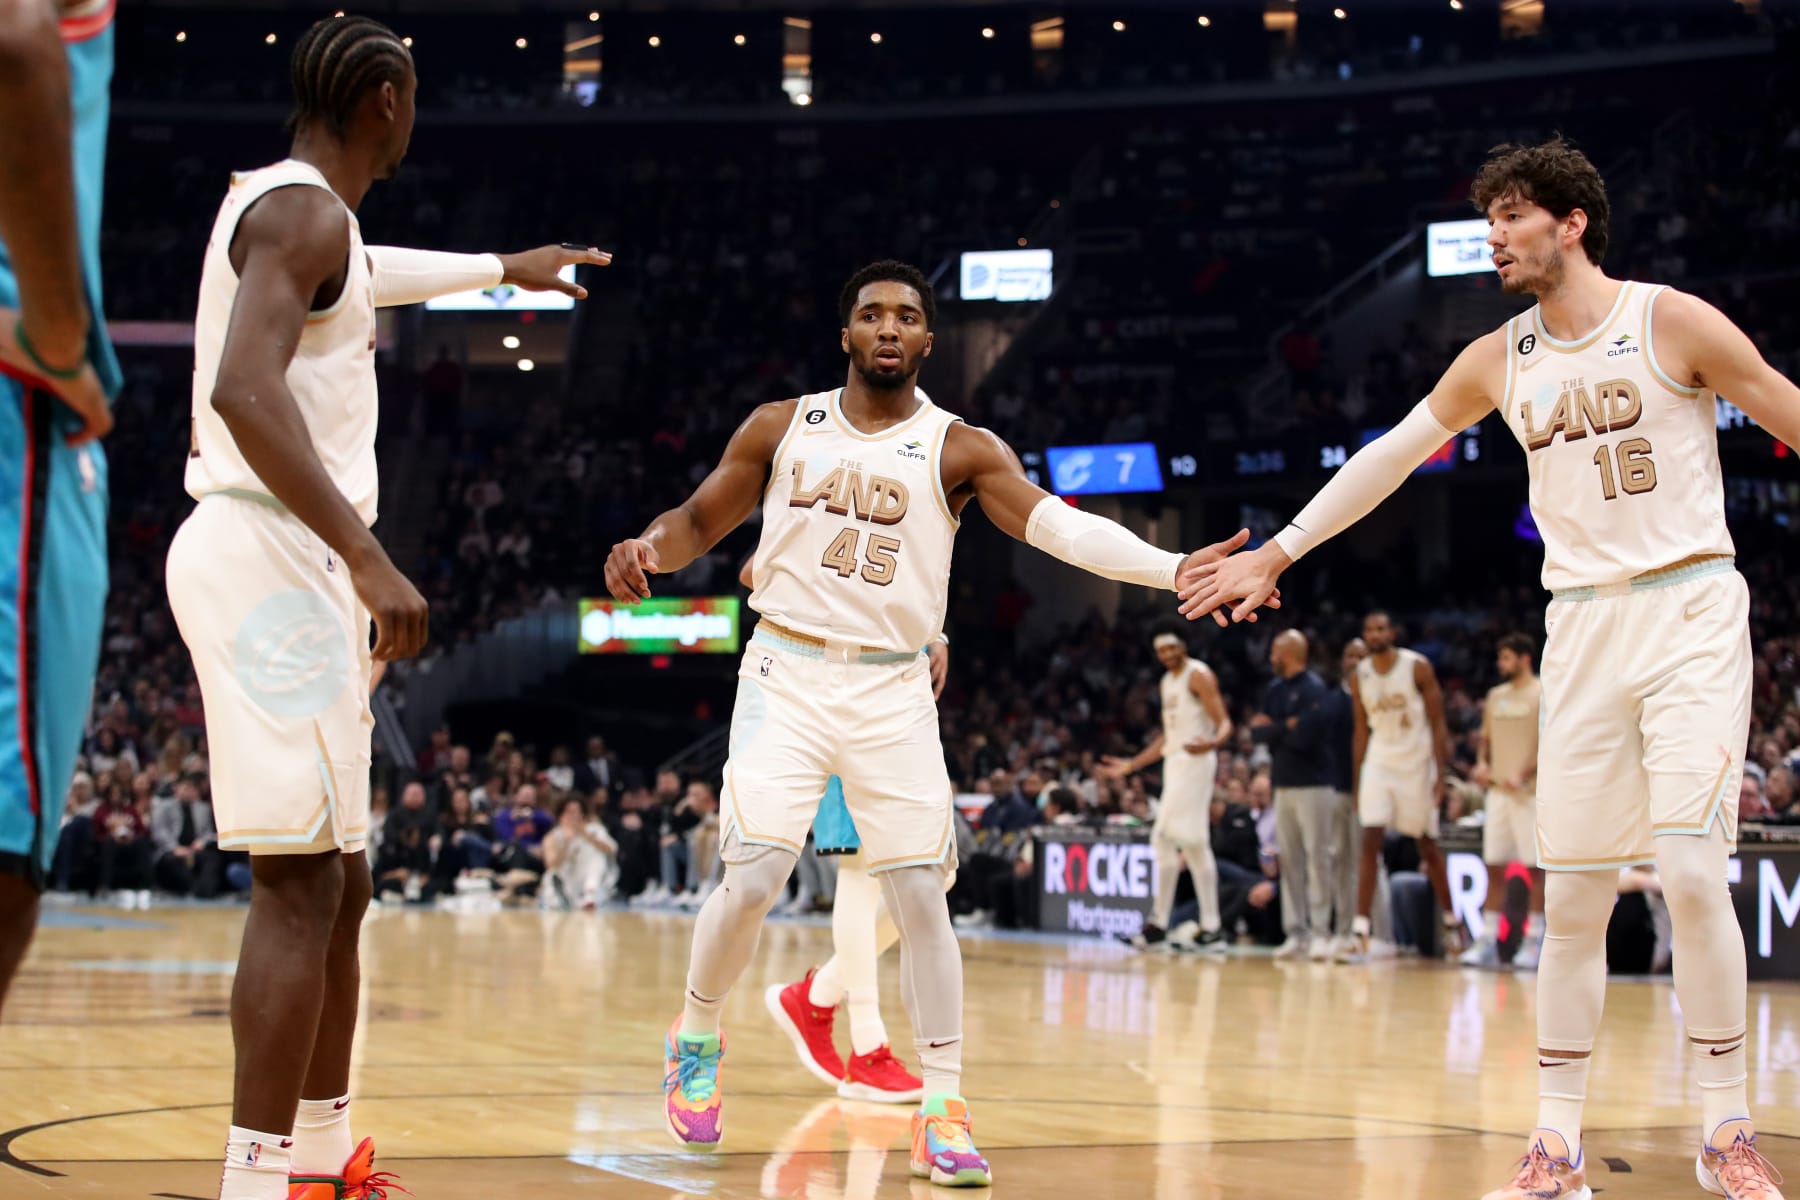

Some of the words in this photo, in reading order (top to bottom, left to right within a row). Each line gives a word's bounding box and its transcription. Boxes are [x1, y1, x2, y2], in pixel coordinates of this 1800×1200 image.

[1522, 338, 1534, 352] 6
[1607, 346, 1639, 357] CLIFFS
[1561, 376, 1585, 391] THE
[811, 411, 823, 424] 6
[1520, 378, 1642, 452] LAND
[839, 457, 864, 471] THE
[897, 449, 926, 461] CLIFFS
[1114, 452, 1136, 484] 7
[1593, 437, 1658, 501] 16
[789, 460, 910, 526] LAND
[821, 527, 901, 587] 45
[1044, 842, 1160, 898] ROCKET
